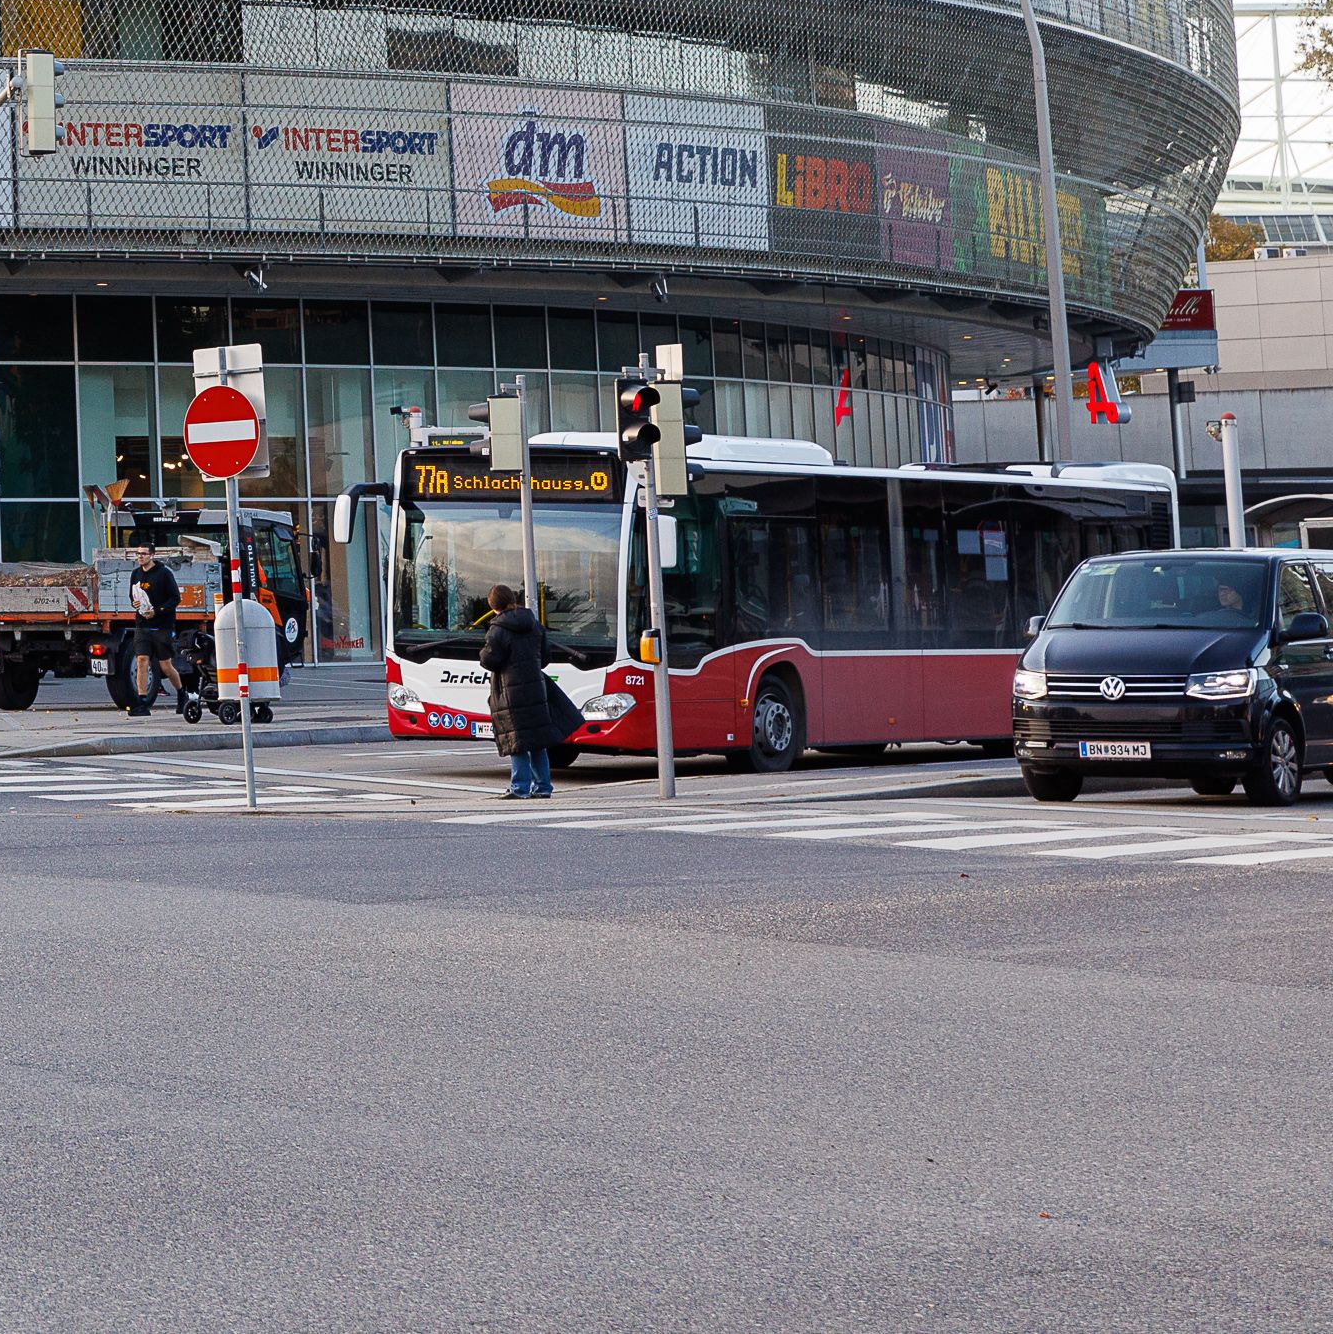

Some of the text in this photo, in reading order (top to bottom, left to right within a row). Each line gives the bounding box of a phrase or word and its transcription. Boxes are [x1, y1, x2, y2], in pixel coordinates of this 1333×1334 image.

[283, 126, 439, 156] INTERSPORT
[505, 112, 586, 178] dm
[71, 156, 203, 178] WINNINGER
[295, 160, 413, 184] WINNINGER
[653, 142, 758, 189] ACTION
[415, 465, 449, 494] 77A
[453, 475, 590, 490] Schlachhausg.
[92, 662, 102, 673] 40
[625, 675, 646, 686] 8721
[1089, 744, 1147, 756] BN 934 MJ
